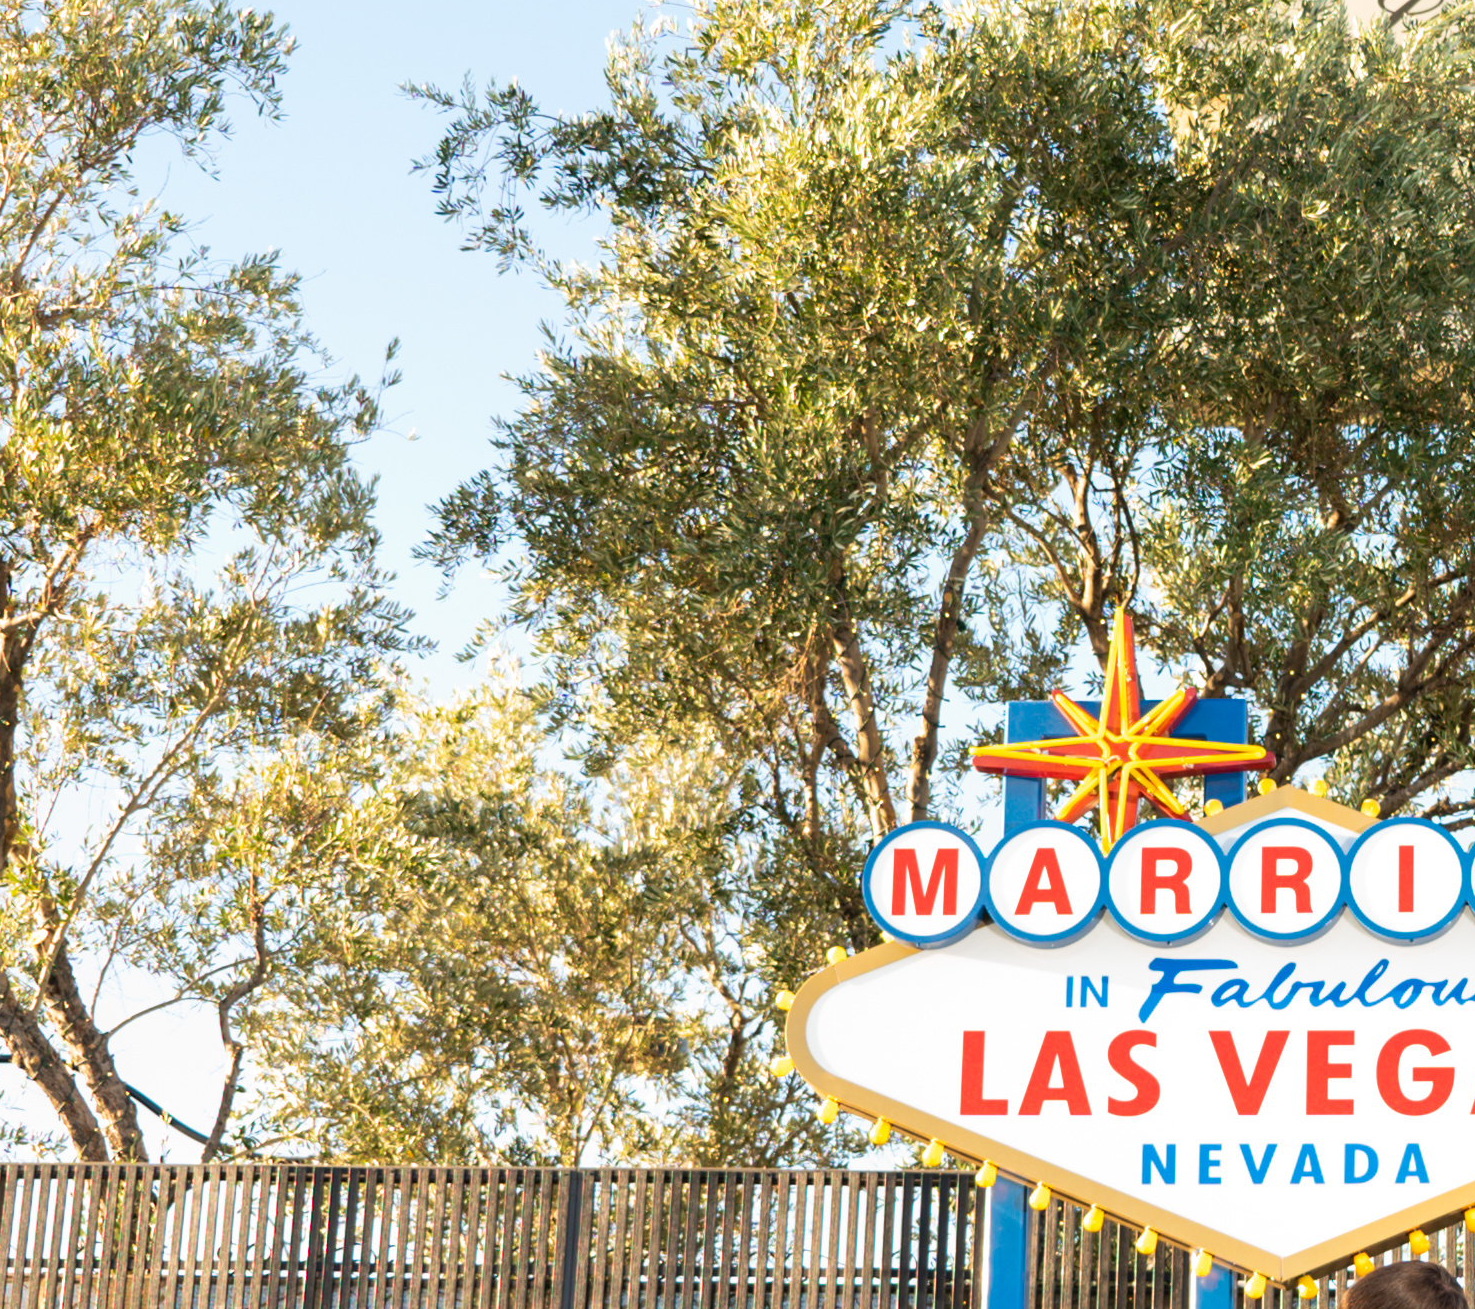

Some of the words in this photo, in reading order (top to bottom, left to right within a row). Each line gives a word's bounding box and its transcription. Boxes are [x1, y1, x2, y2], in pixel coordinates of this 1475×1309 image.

[1065, 975, 1110, 1008] IN
[959, 1029, 1161, 1117] LAS
[1141, 1142, 1430, 1185] NEVADA
